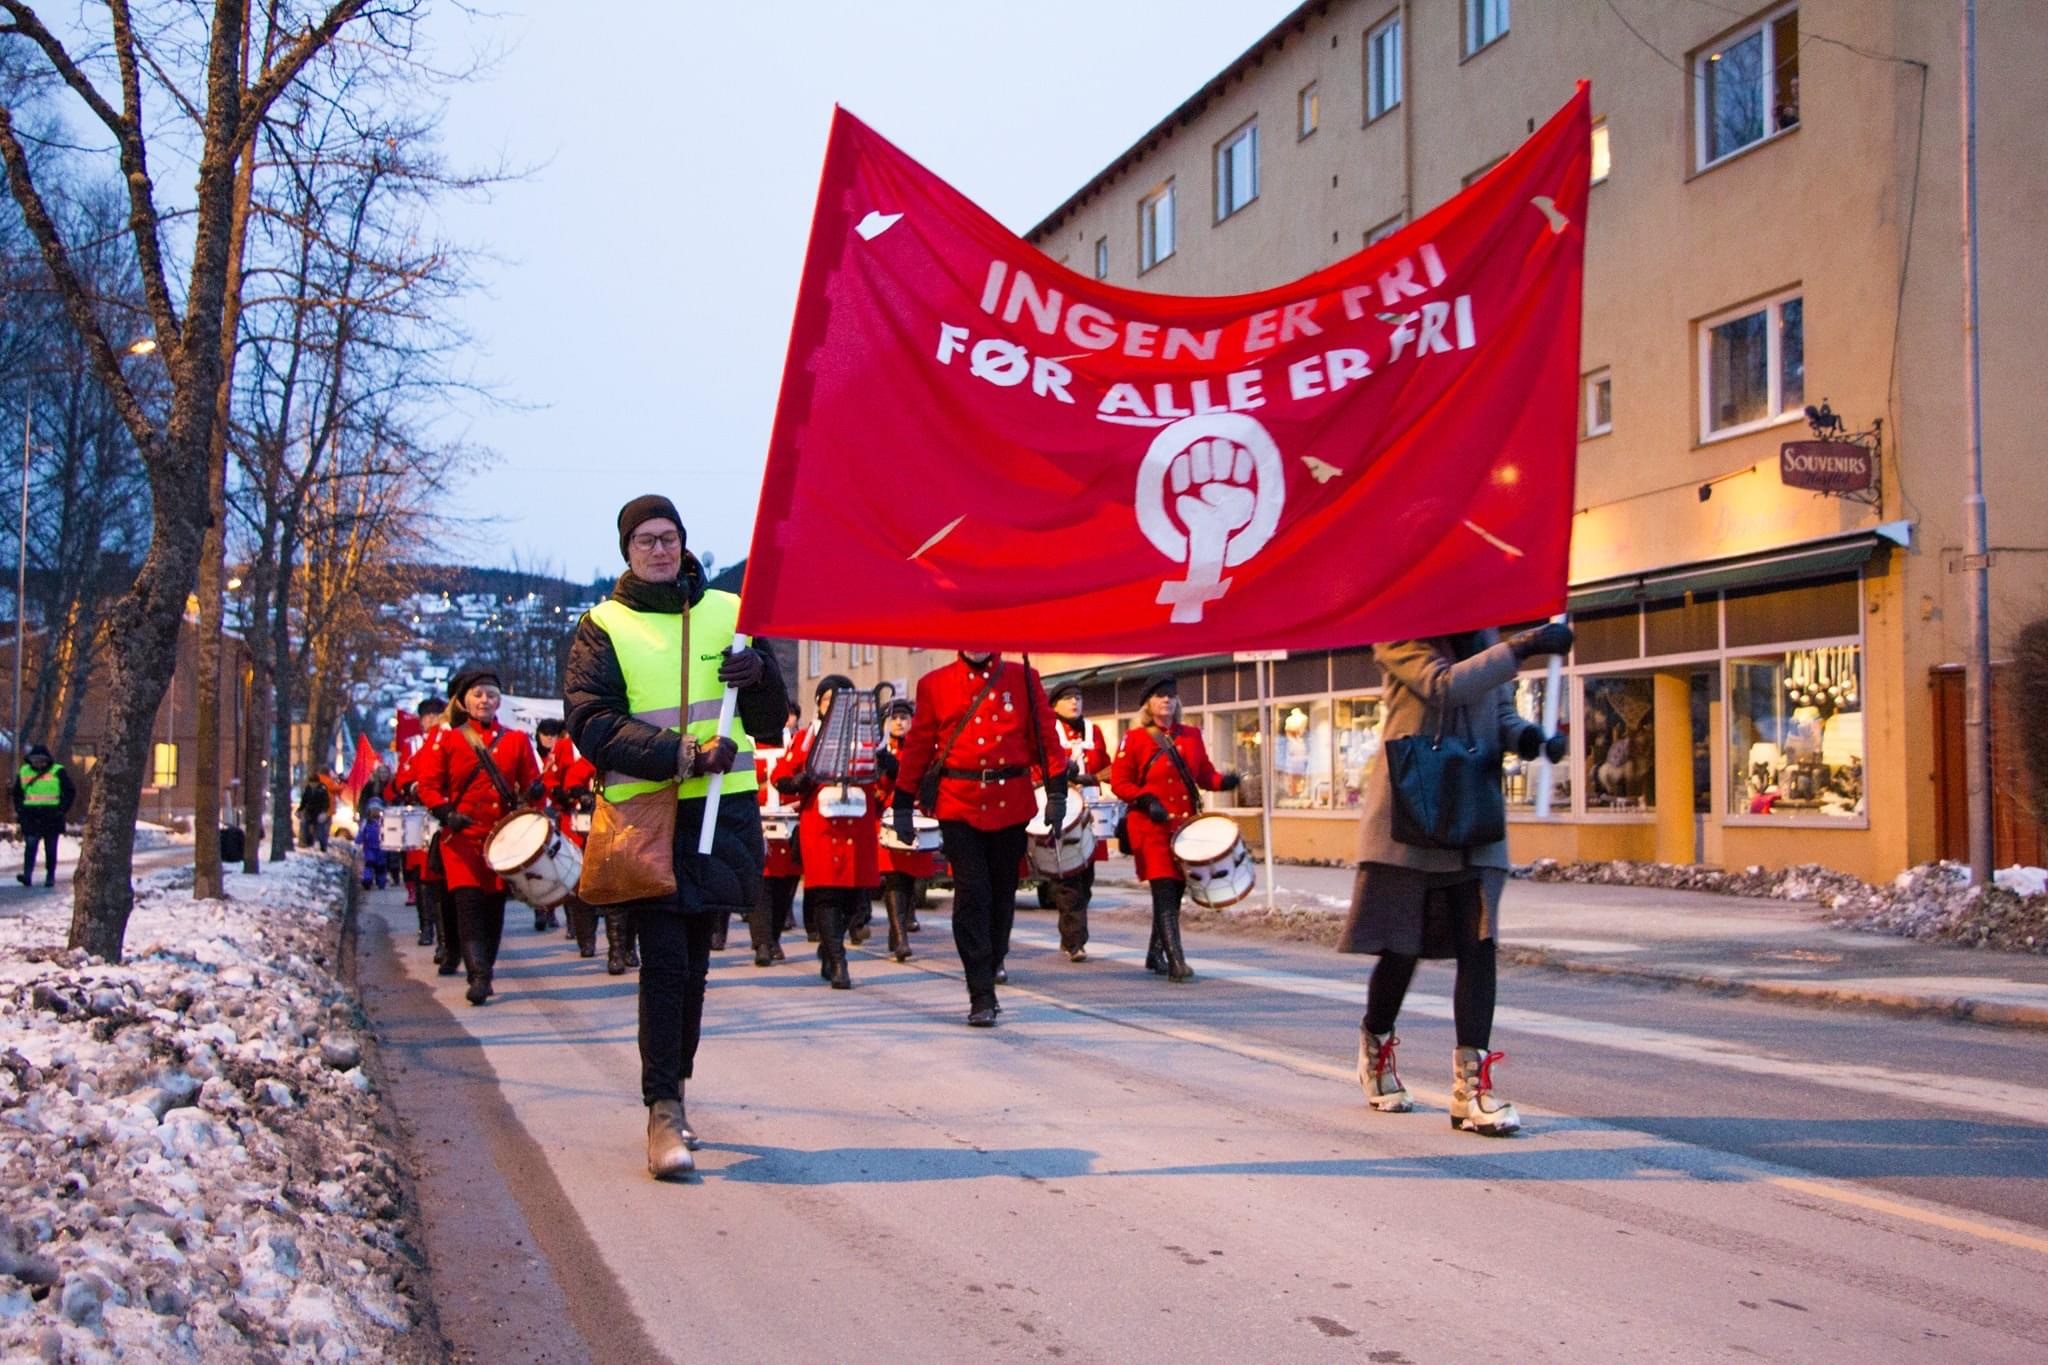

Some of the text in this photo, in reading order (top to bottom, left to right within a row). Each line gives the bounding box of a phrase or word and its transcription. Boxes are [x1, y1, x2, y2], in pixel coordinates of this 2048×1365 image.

[936, 294, 1476, 418] FØR ALLE ER FRI
[980, 260, 1222, 360] INGEN
[1244, 299, 1323, 353] ER
[1784, 448, 1867, 474] SOUVENIRS
